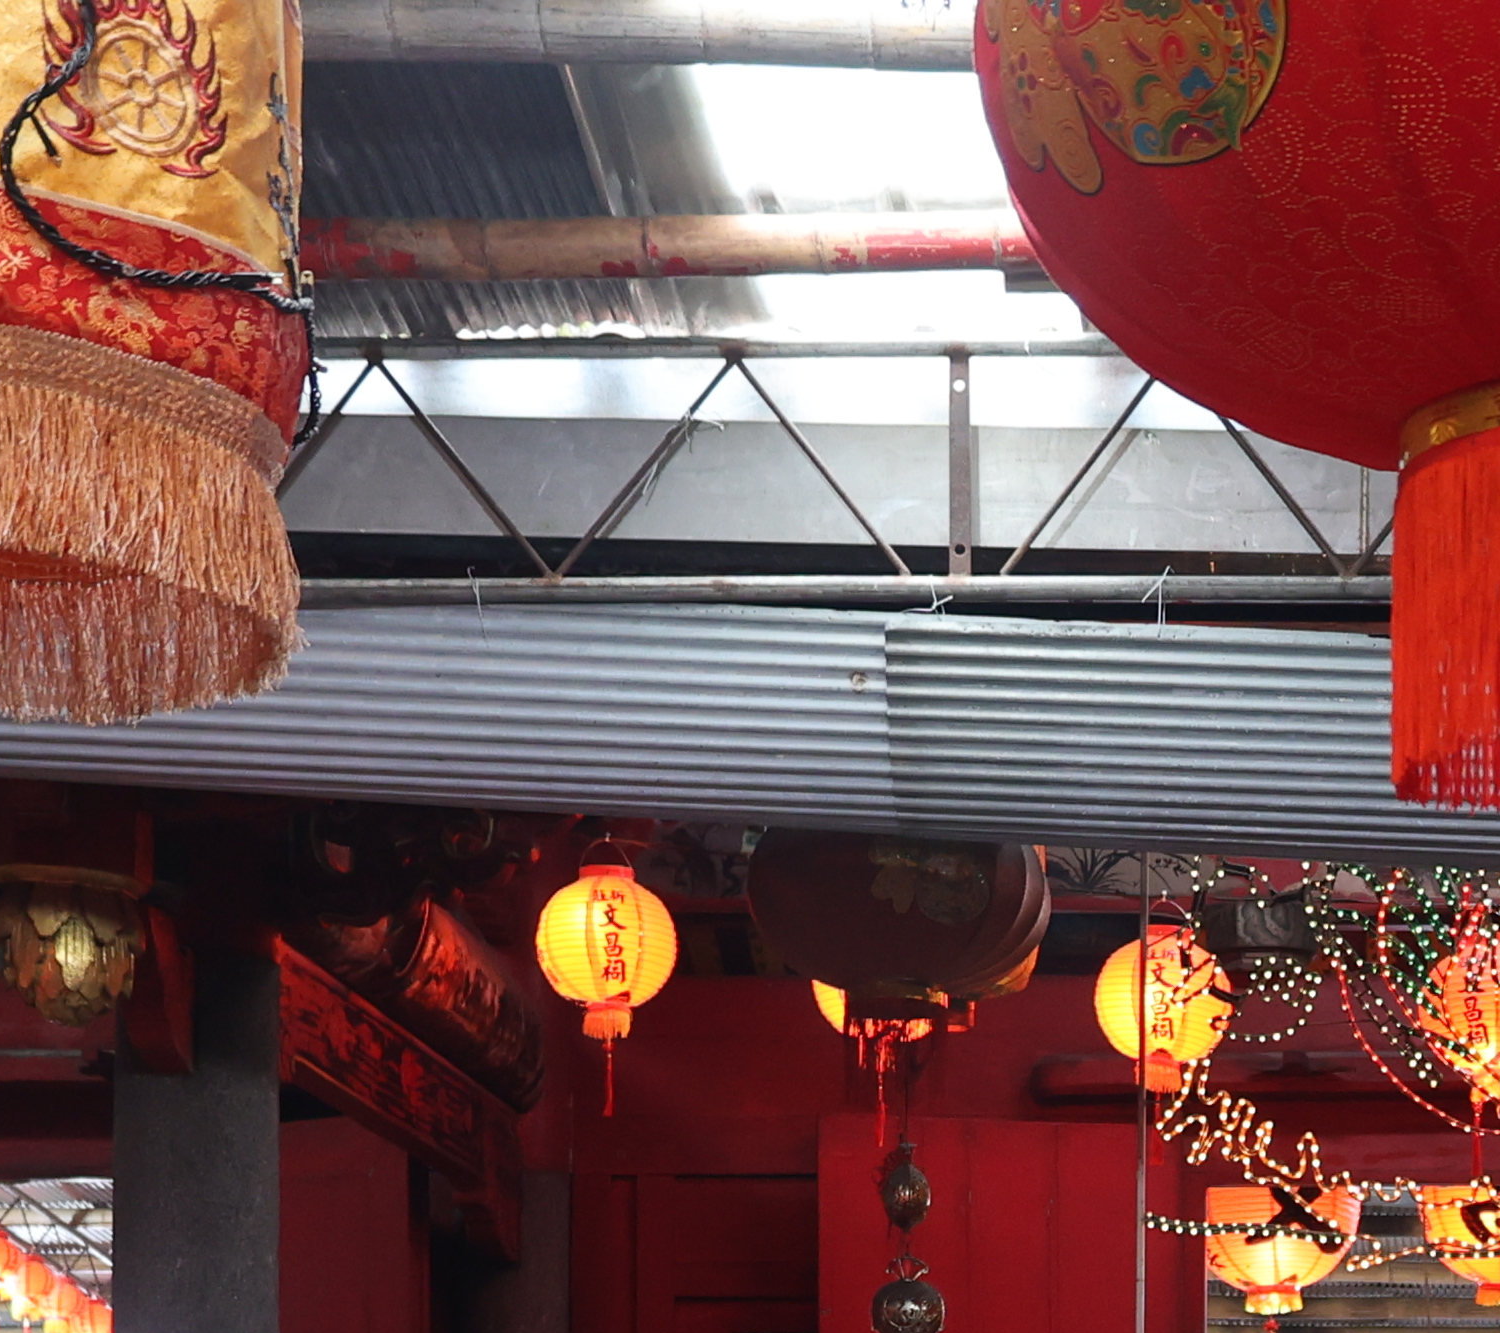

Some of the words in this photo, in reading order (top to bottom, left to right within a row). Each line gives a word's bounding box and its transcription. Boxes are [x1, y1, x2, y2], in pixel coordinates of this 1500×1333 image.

[599, 904, 627, 984] 文昌祠
[1145, 962, 1175, 1040] 文昌祠
